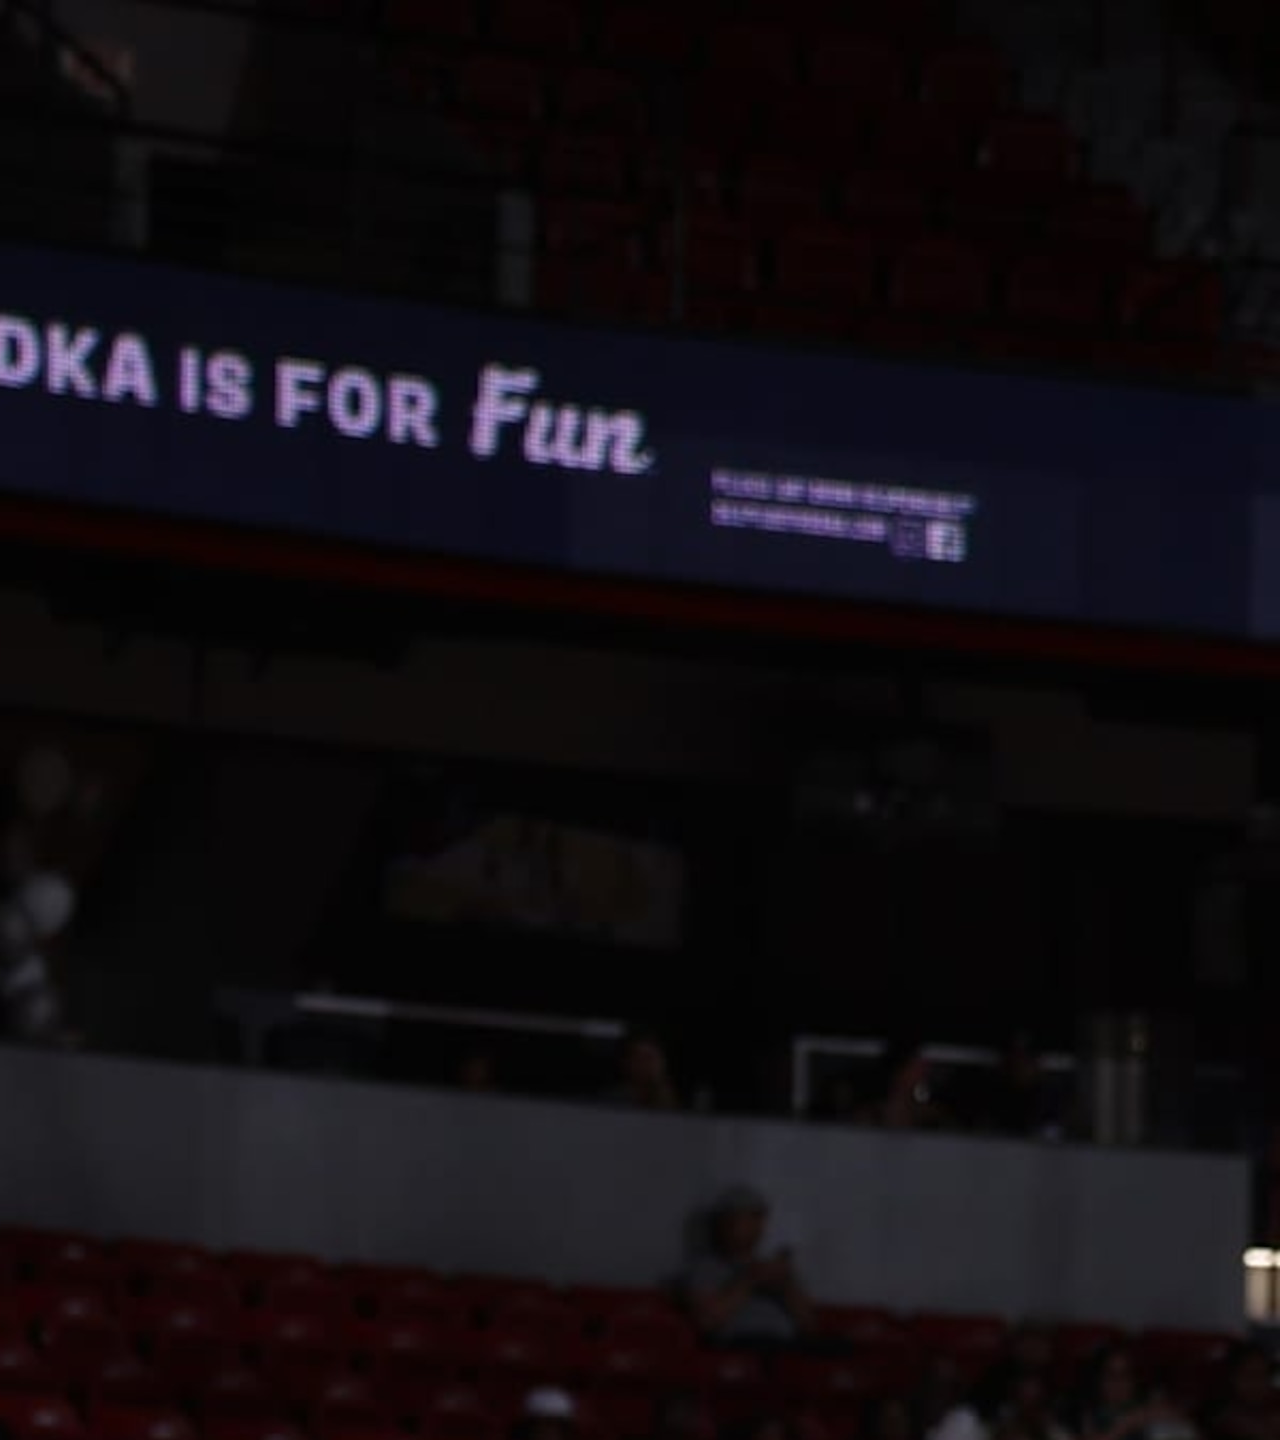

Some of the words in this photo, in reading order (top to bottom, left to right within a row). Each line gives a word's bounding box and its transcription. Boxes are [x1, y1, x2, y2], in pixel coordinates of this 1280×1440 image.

[180, 347, 252, 420] IS
[275, 360, 438, 449] FOR
[470, 365, 655, 476] Fun
